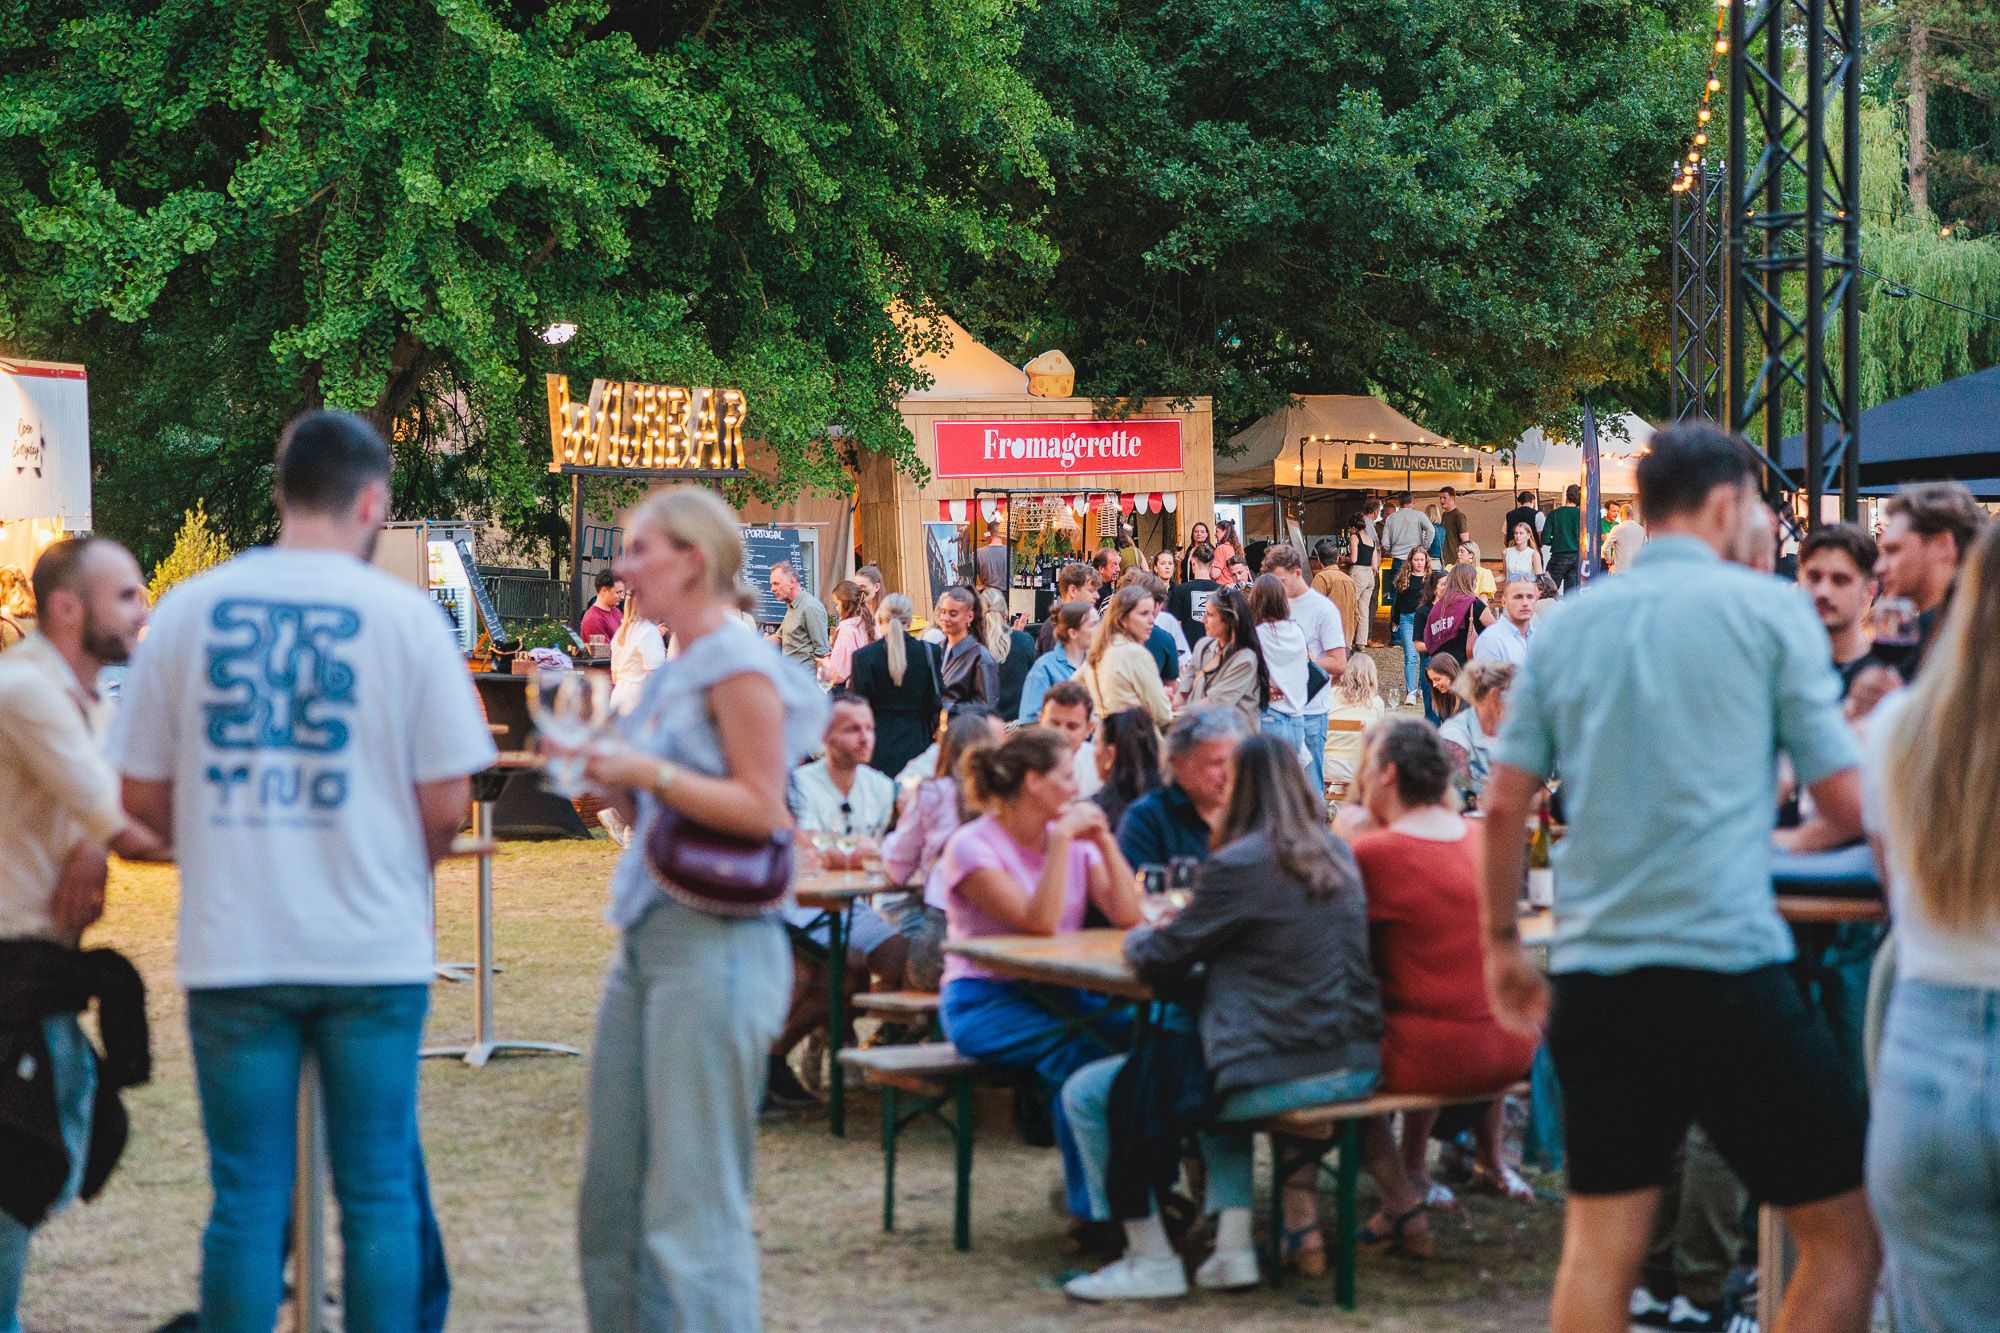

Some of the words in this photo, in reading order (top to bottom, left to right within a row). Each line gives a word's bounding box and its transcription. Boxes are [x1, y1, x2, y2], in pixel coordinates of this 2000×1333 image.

[983, 429, 1142, 468] Fromagerette
[1368, 456, 1385, 468] DE
[1391, 456, 1463, 471] WIJNGALERIJ
[745, 529, 784, 540] PORTUGAL
